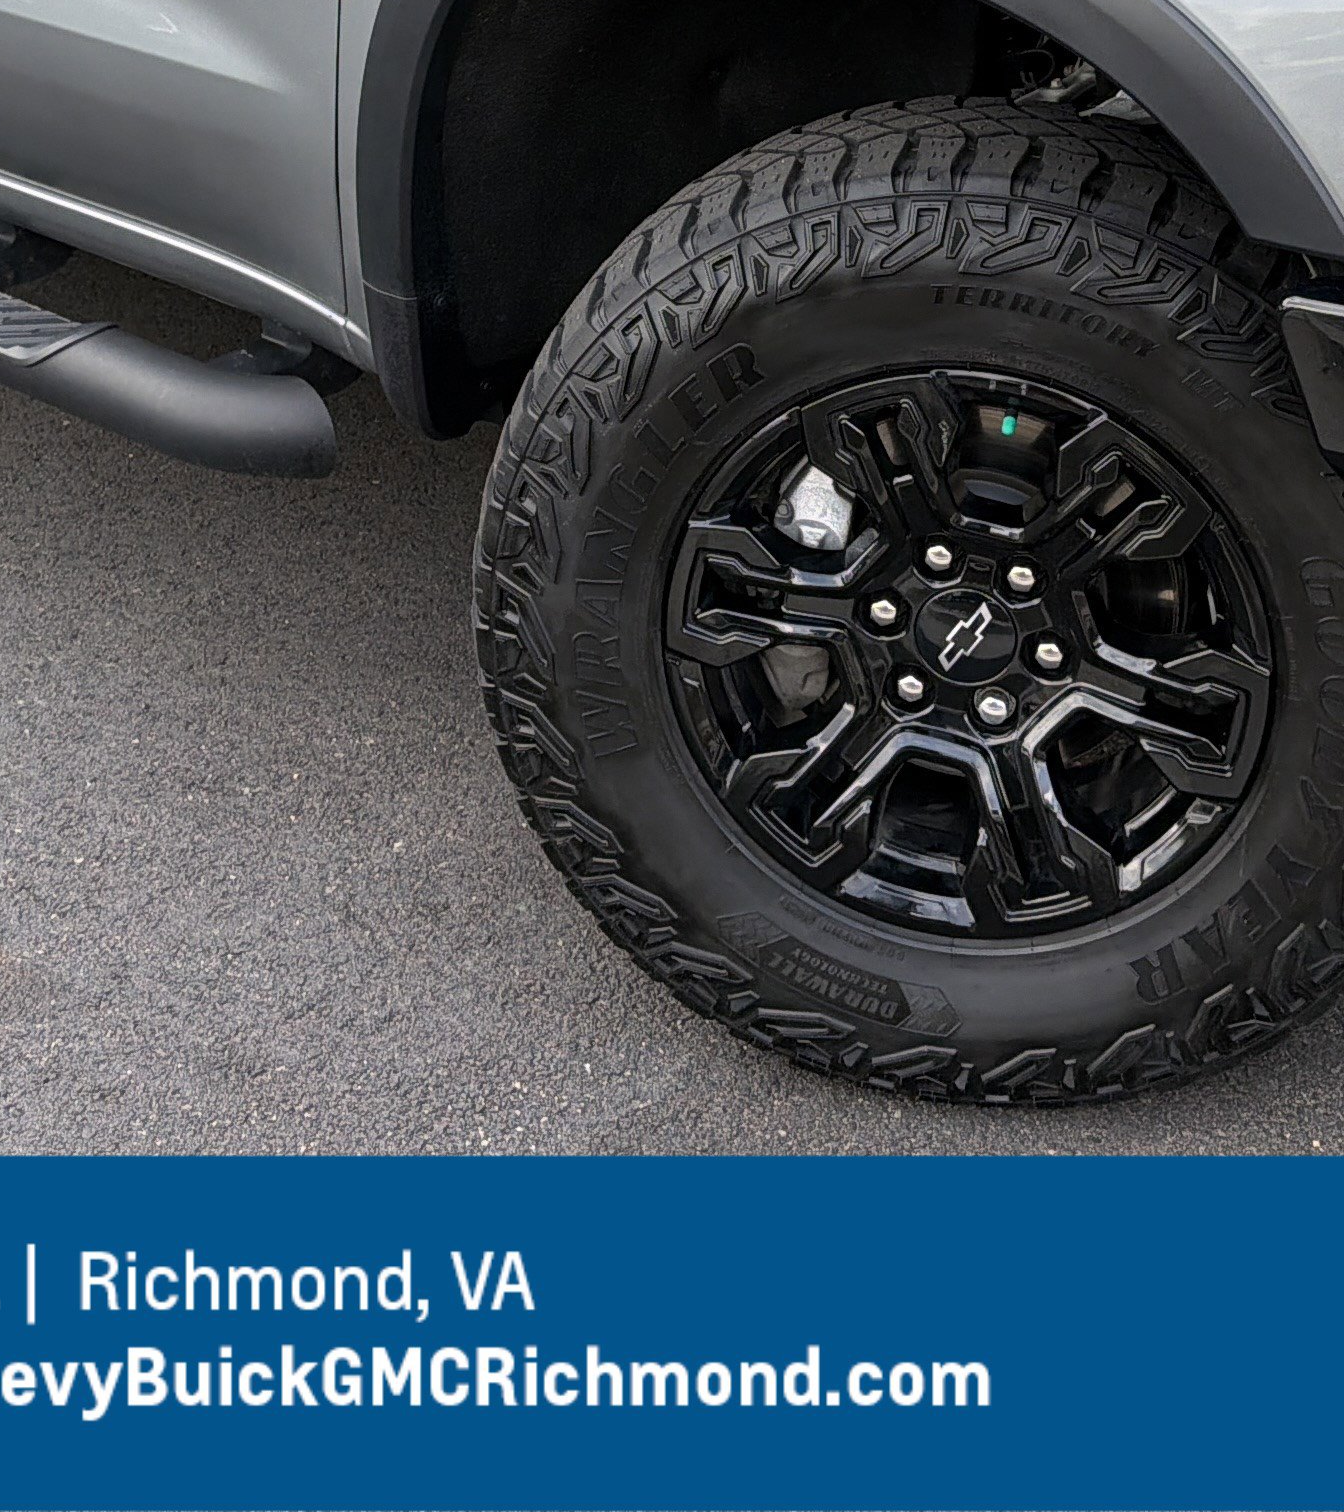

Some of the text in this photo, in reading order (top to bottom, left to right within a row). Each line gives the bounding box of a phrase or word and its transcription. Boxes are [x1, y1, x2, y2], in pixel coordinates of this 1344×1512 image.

[930, 284, 1160, 358] TERRITORY
[571, 342, 764, 758] WRANGLER
[767, 952, 899, 1020] DURAWALL
